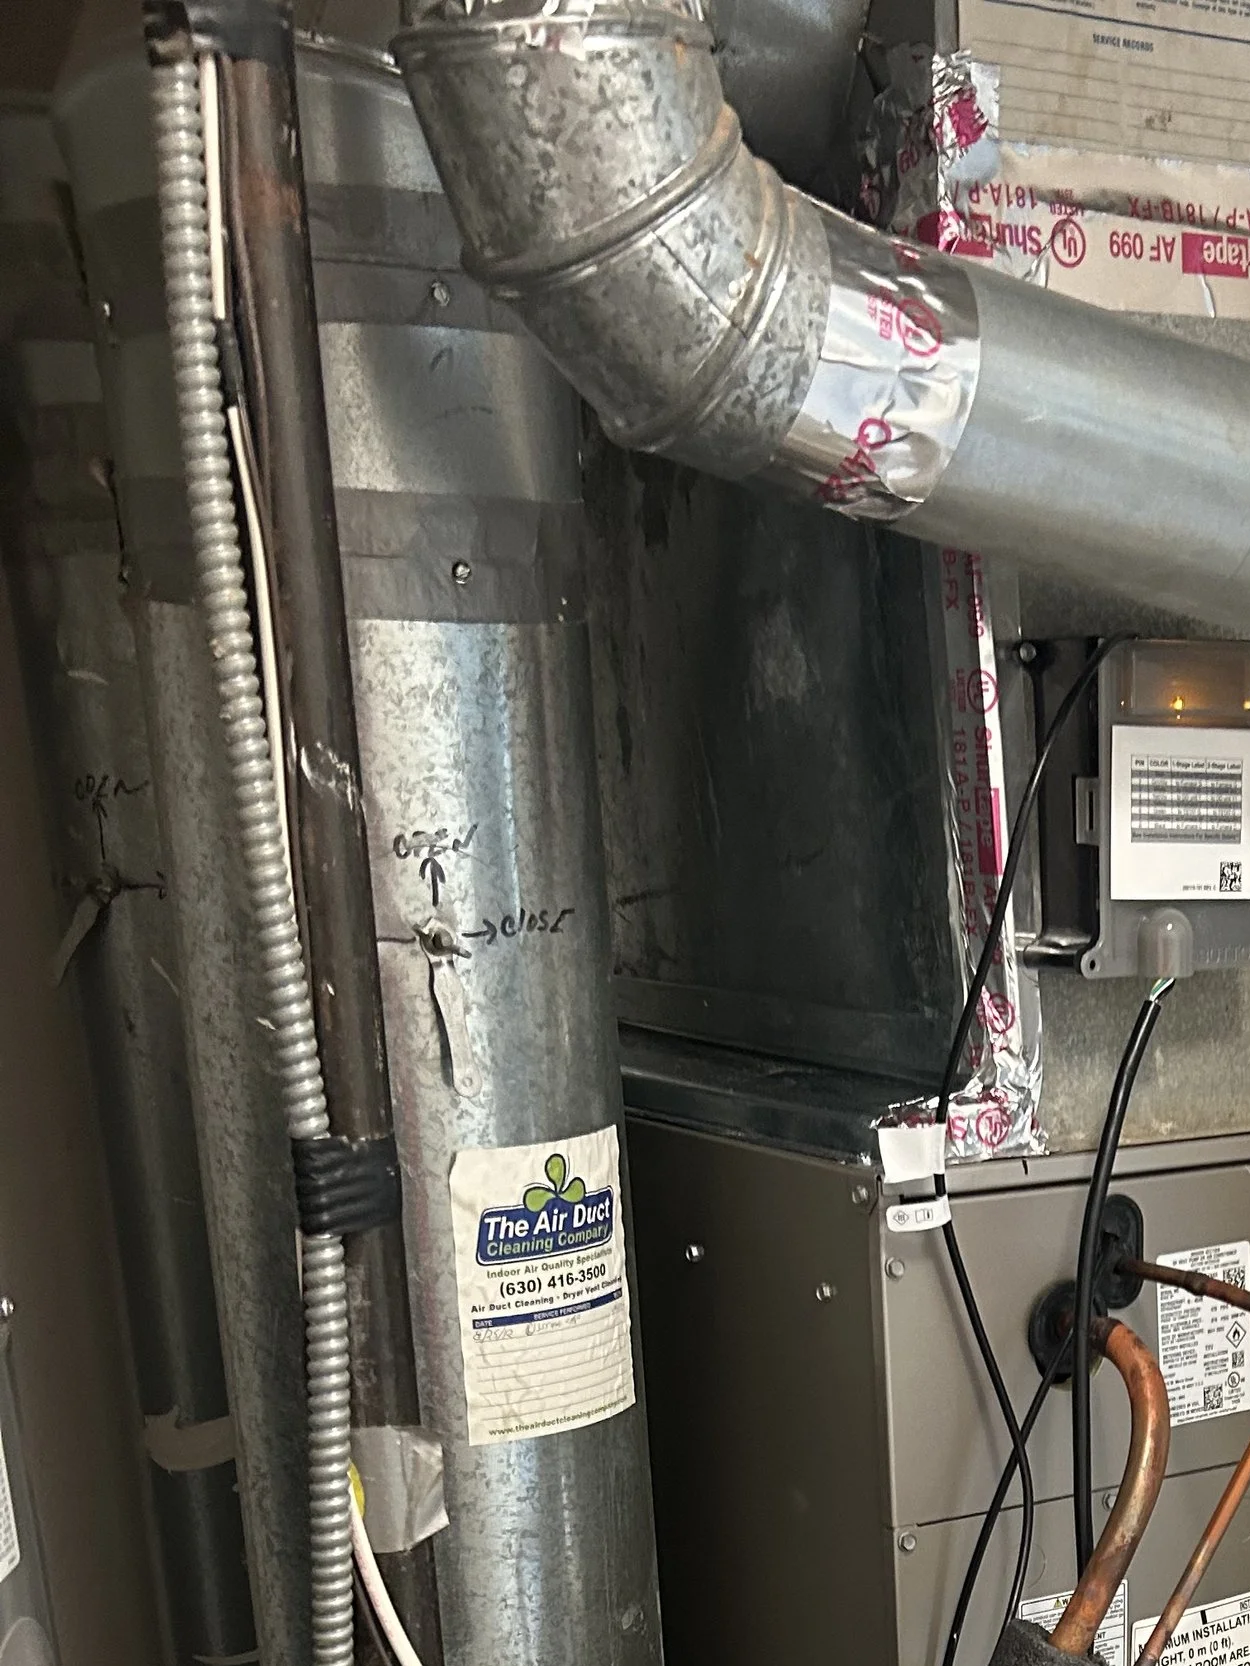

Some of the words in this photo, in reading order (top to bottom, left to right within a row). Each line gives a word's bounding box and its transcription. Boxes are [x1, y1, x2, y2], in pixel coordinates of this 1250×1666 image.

[1108, 229, 1144, 261] 099
[1149, 233, 1176, 264] AF
[484, 1216, 530, 1242] The
[533, 1208, 568, 1236] Air
[573, 1198, 611, 1229] Duct
[487, 1236, 554, 1257] Cleaning
[558, 1223, 609, 1247] Company
[487, 1266, 521, 1280] Indoor
[524, 1265, 539, 1276] Air
[541, 1259, 574, 1273] Quality
[500, 1277, 542, 1299] (630)
[547, 1263, 606, 1290] 416-3500
[471, 1305, 486, 1314] Air
[489, 1302, 511, 1312] Duct
[514, 1297, 554, 1310] Cleaning
[563, 1289, 584, 1301] Dryer
[585, 1284, 601, 1295] Vent
[474, 1320, 494, 1328] DATE
[533, 1310, 559, 1321] SERVICE
[1188, 1648, 1195, 1659] 0
[1197, 1646, 1207, 1657] m
[1209, 1641, 1219, 1656] (0
